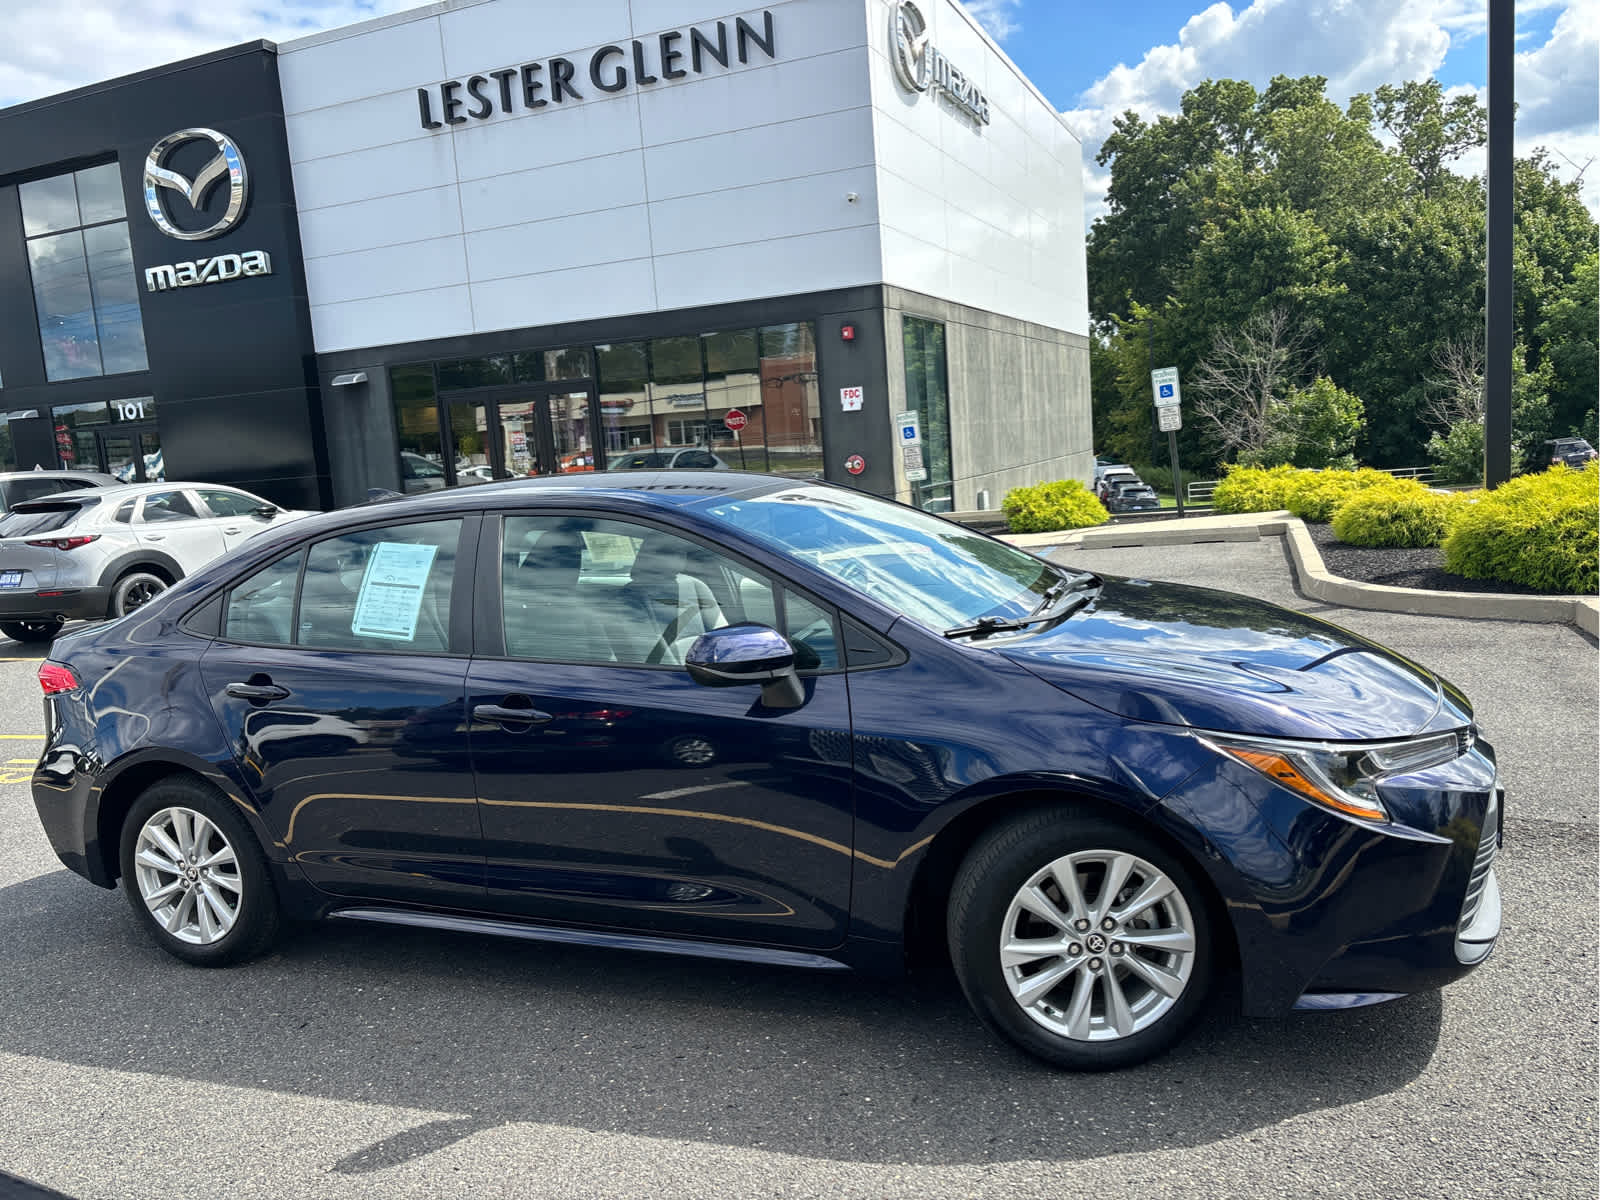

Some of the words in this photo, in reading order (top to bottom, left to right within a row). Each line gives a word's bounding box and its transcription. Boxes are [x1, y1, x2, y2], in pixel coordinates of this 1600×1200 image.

[417, 57, 583, 130] LESTER
[589, 10, 777, 93] GLENN
[843, 389, 861, 399] FDC
[117, 402, 144, 421] 101
